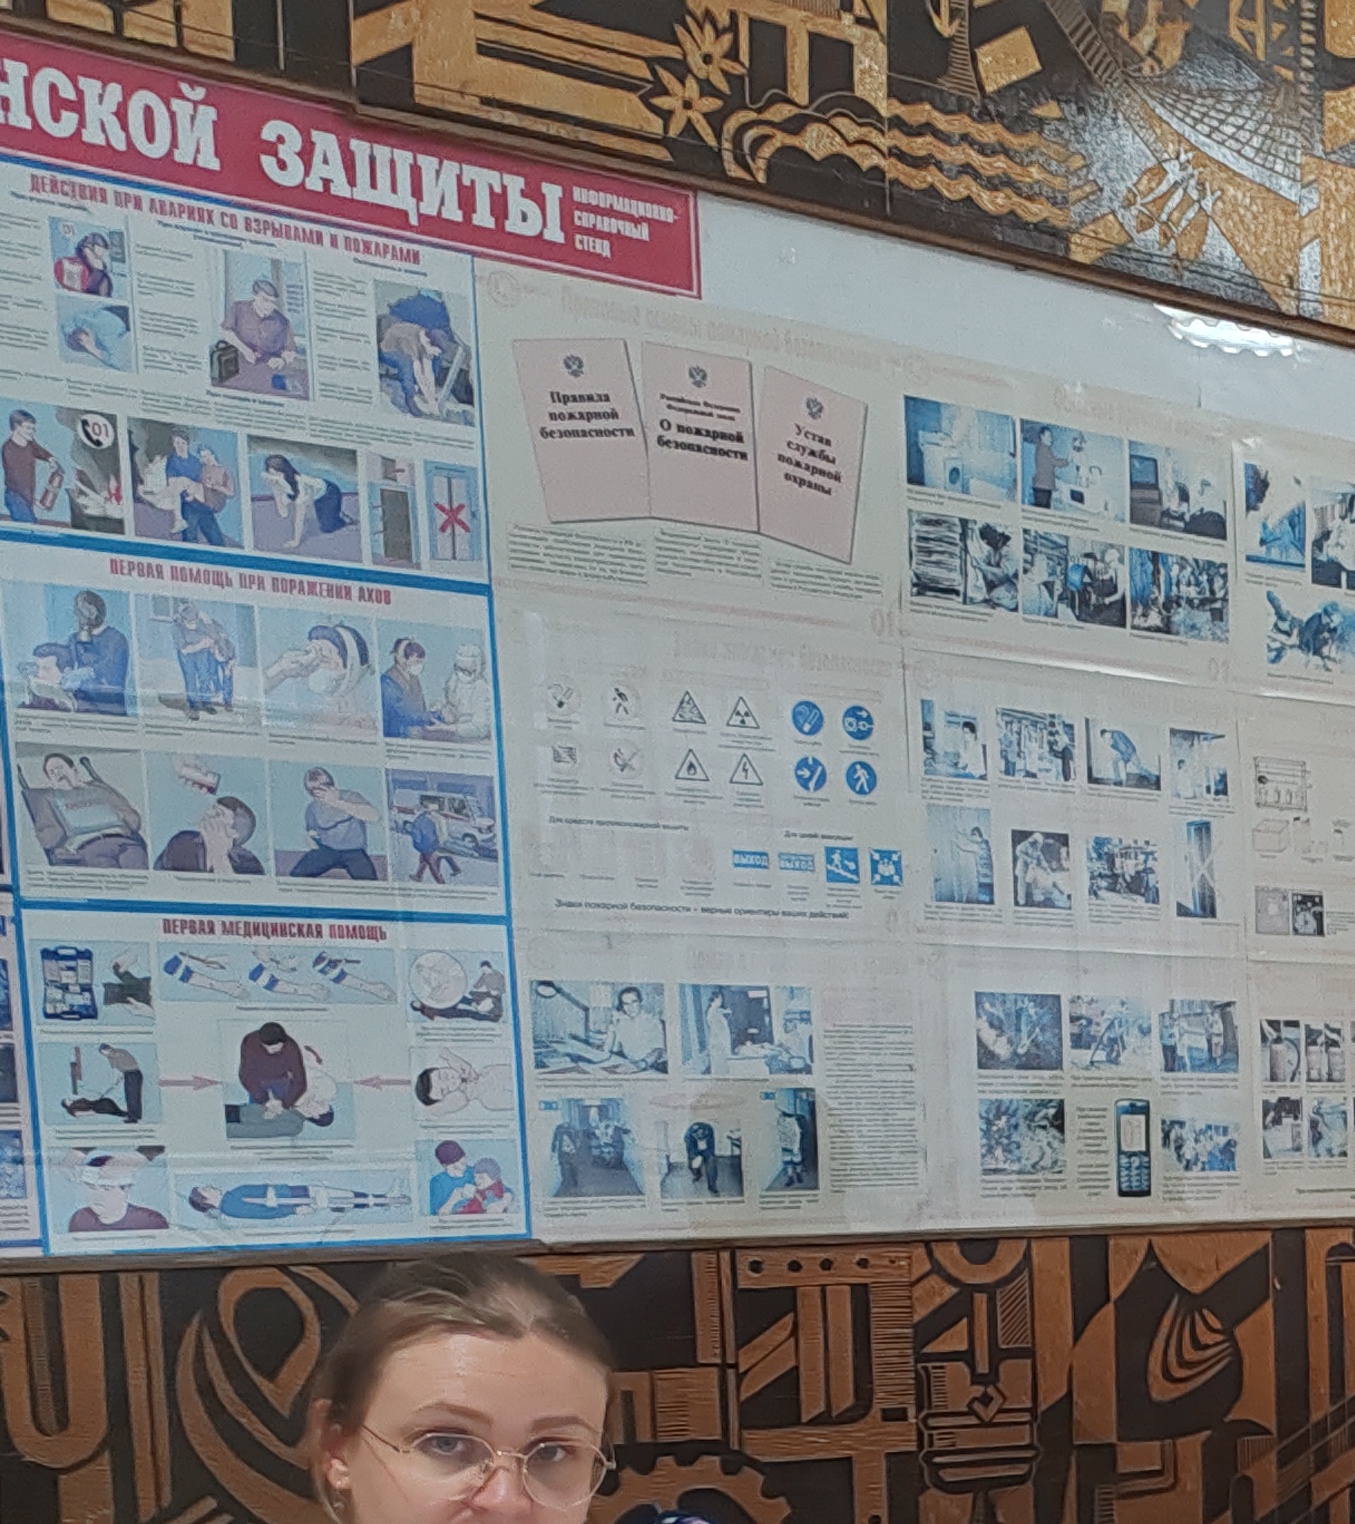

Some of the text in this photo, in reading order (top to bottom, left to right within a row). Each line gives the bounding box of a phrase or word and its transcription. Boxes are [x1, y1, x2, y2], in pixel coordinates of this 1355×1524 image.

[0, 58, 565, 244] НСКОЙ ЗАЩИТЫ
[30, 173, 107, 204] ДЕЙСТВИЯ
[113, 190, 143, 211] ПРИ
[149, 197, 214, 225] АВАРИЯХ
[220, 211, 238, 230] СО
[244, 216, 324, 247] ВЗРЫВАМИ
[330, 233, 338, 249] И
[344, 235, 420, 265] ПОЖАРАМИ
[574, 210, 650, 241] СПРАВОЧНЫЙ
[575, 234, 611, 258] СТЕНД
[549, 391, 611, 406] Правила
[548, 407, 619, 423] пожарной
[92, 421, 109, 440] 01
[540, 427, 635, 439] безопасности
[660, 419, 745, 444] О пожарной
[794, 423, 832, 447] Устав
[657, 435, 748, 461] безопасности
[786, 440, 836, 465] службы
[777, 453, 842, 483] пожарной
[784, 472, 832, 496] охраны
[110, 558, 391, 605] ПЕРВАЯ ПОМОЩЬ ПРИ ПОРАЖЕНИИ АХОВ
[734, 853, 769, 866] ВЫХОД
[162, 918, 387, 942] ПЕРВАЯ МЕДИЦИНСКАЯ ПОМОЩЬ
